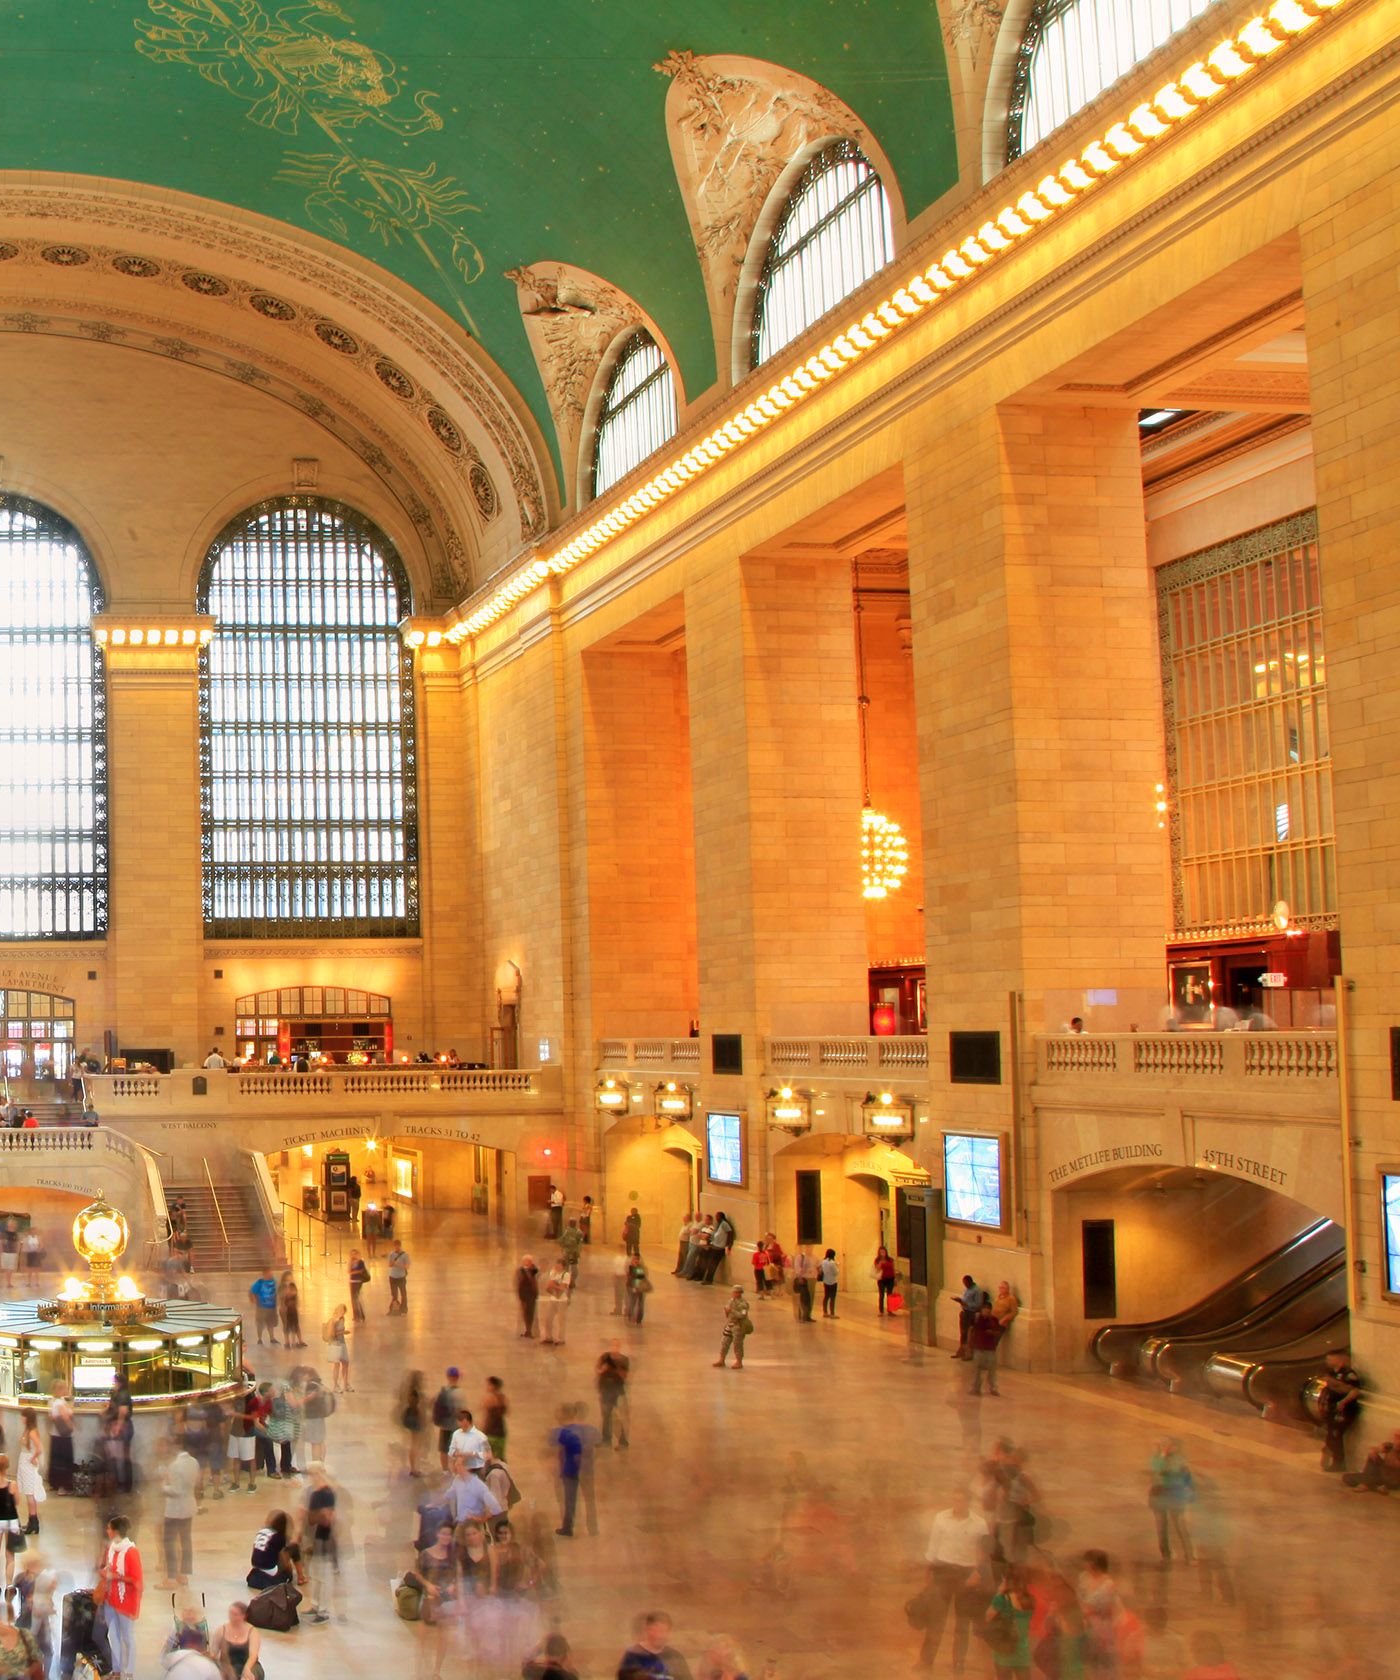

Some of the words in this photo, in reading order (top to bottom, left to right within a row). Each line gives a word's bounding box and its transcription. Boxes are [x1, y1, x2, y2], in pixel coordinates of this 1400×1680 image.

[183, 1121, 218, 1129] BALCONY
[404, 1125, 442, 1135] TRACKS
[443, 1128, 453, 1136] 31
[455, 1130, 468, 1139] TO
[283, 1133, 316, 1146] TICKET
[320, 1127, 371, 1139] MACHINES
[1049, 1164, 1068, 1182] THE
[1069, 1149, 1110, 1173] METLIFE
[1112, 1143, 1162, 1161] BUILDING
[1203, 1149, 1234, 1169] 45TH
[1236, 1156, 1287, 1185] STREET
[36, 1178, 61, 1187] TRACKS
